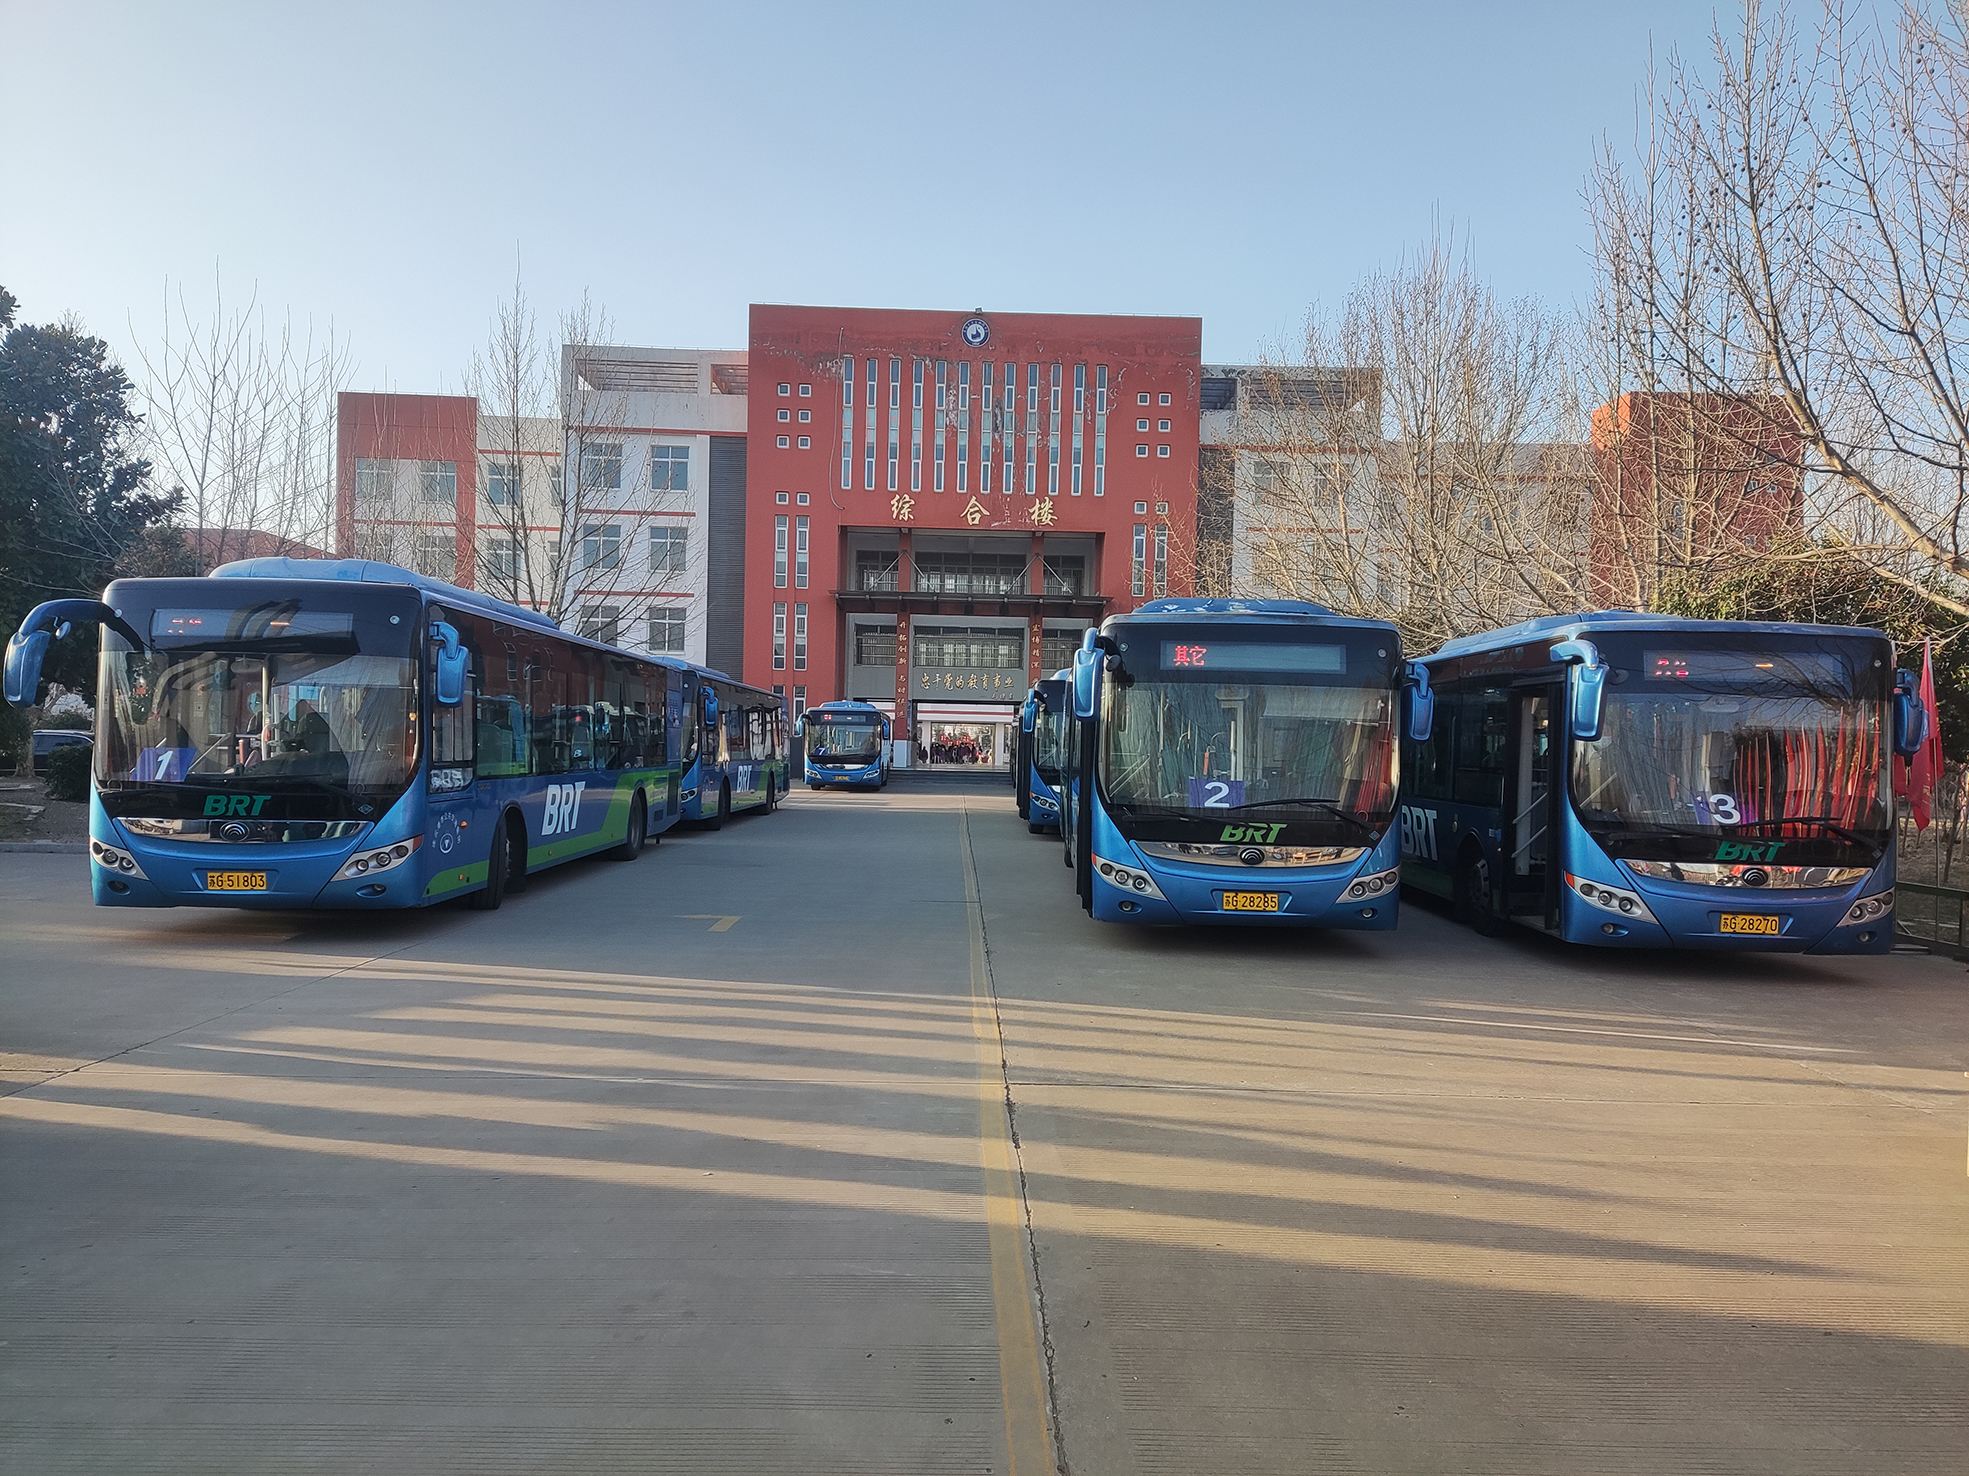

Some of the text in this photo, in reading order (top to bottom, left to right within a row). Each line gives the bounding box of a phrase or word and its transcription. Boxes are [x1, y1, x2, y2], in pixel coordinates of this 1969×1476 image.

[890, 494, 1058, 527] 综合楼
[1173, 645, 1207, 666] 其它
[920, 672, 1014, 691] 忠于党的教育事业
[155, 750, 174, 780] 1
[818, 747, 826, 756] 7
[737, 765, 752, 794] BRT
[203, 795, 272, 816] BRT
[1204, 781, 1230, 808] 2
[541, 781, 586, 836] BRT
[1709, 793, 1741, 825] 3
[1220, 823, 1288, 843] BRT
[1402, 804, 1438, 861] BRT
[1715, 840, 1786, 862] BRT
